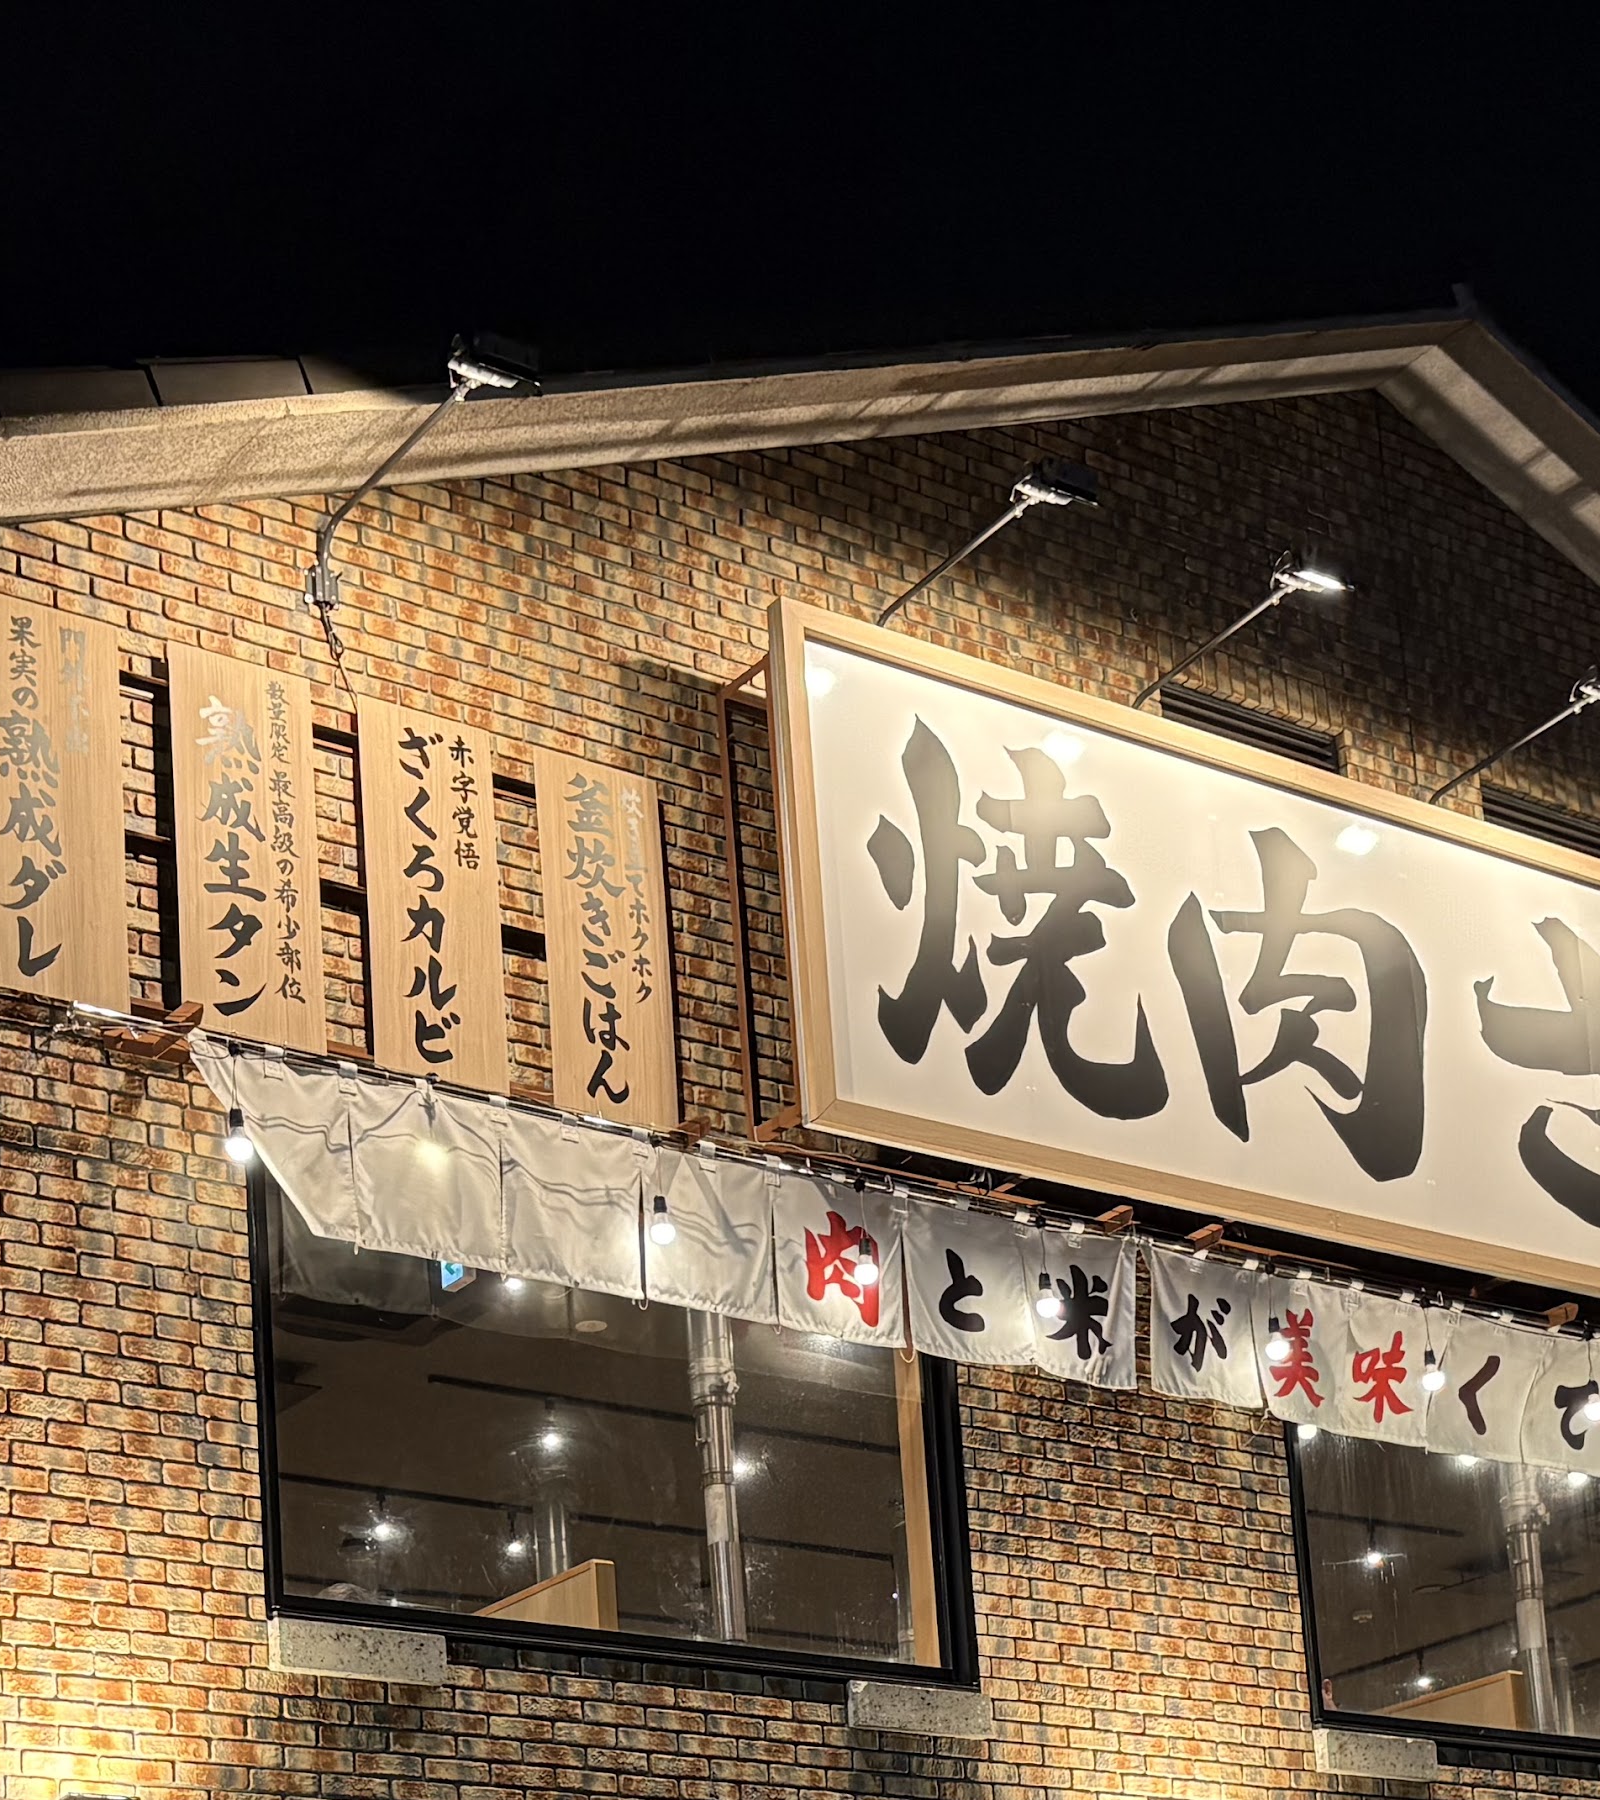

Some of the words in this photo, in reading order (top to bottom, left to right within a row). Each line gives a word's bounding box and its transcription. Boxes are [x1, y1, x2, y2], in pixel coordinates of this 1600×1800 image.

[194, 694, 268, 1017] 熟成生タン
[397, 726, 461, 1065] ざくろカルビ
[448, 735, 481, 872] 赤字覚悟
[563, 771, 630, 1104] 釜炊きごはん
